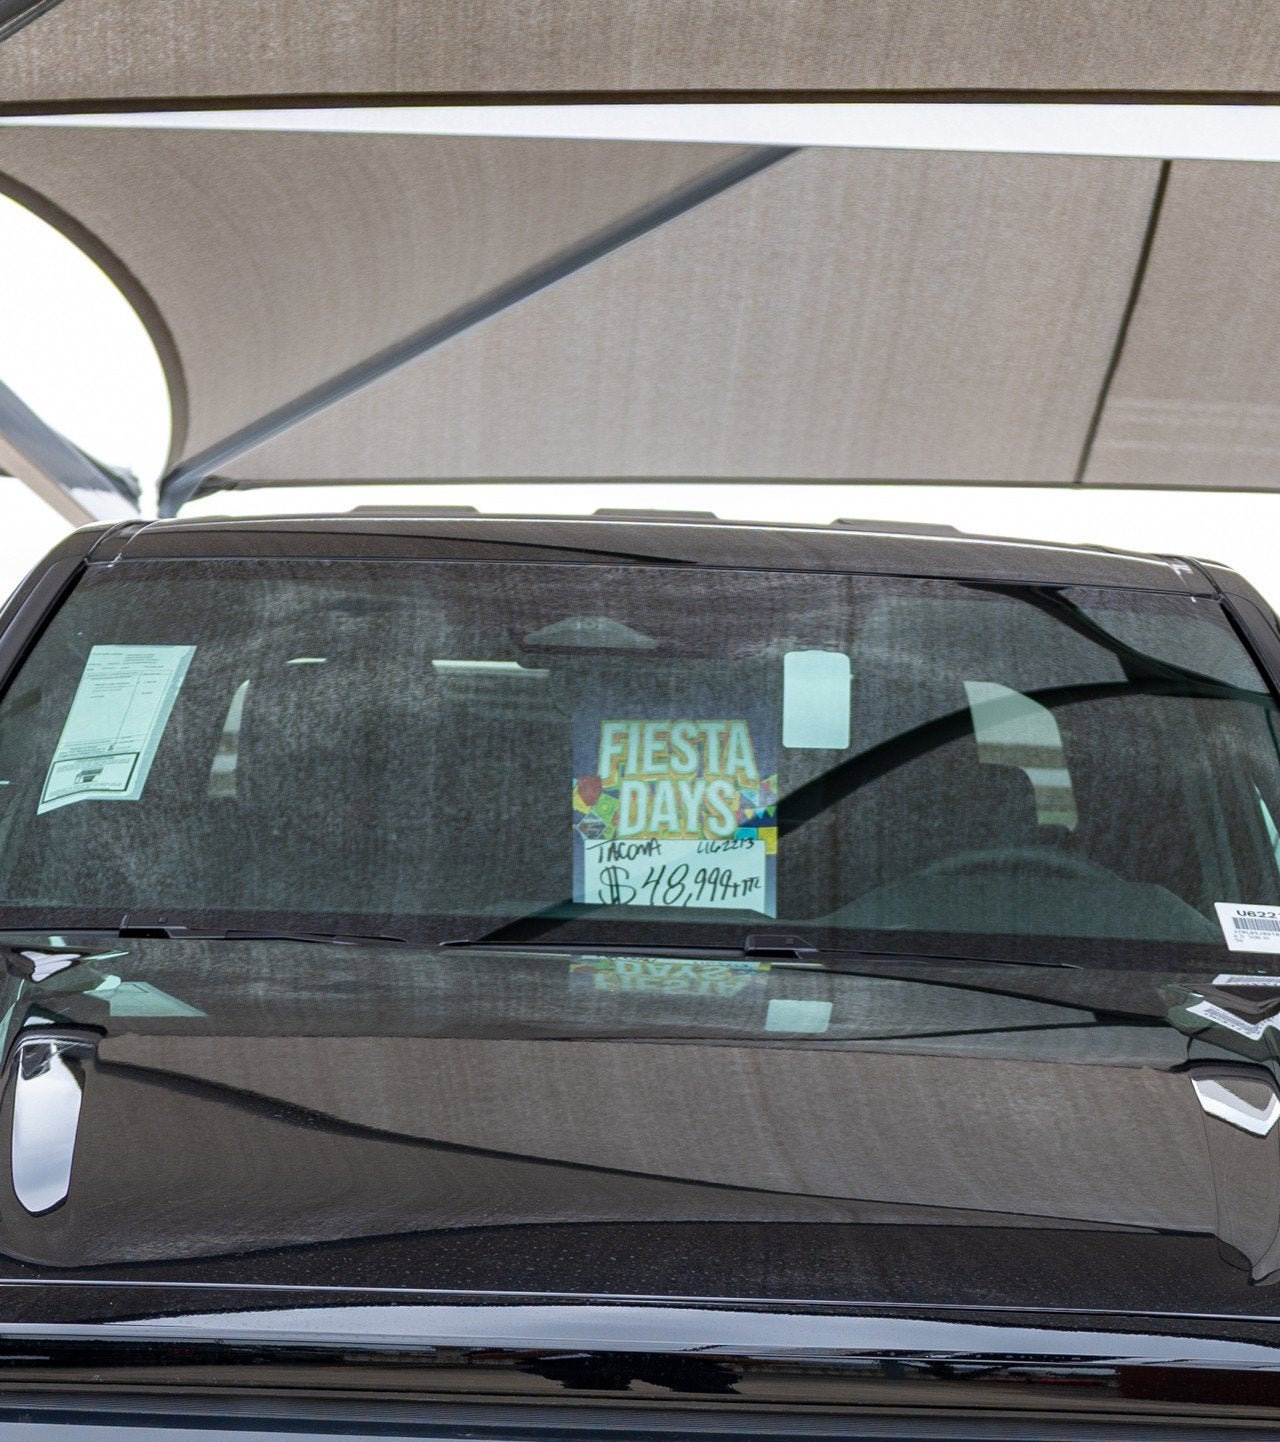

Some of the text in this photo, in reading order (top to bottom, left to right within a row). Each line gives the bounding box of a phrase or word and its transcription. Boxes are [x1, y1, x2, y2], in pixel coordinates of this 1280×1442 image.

[598, 720, 758, 781] FIESTA
[618, 779, 736, 837] DAYS
[587, 837, 661, 863] TACOMA
